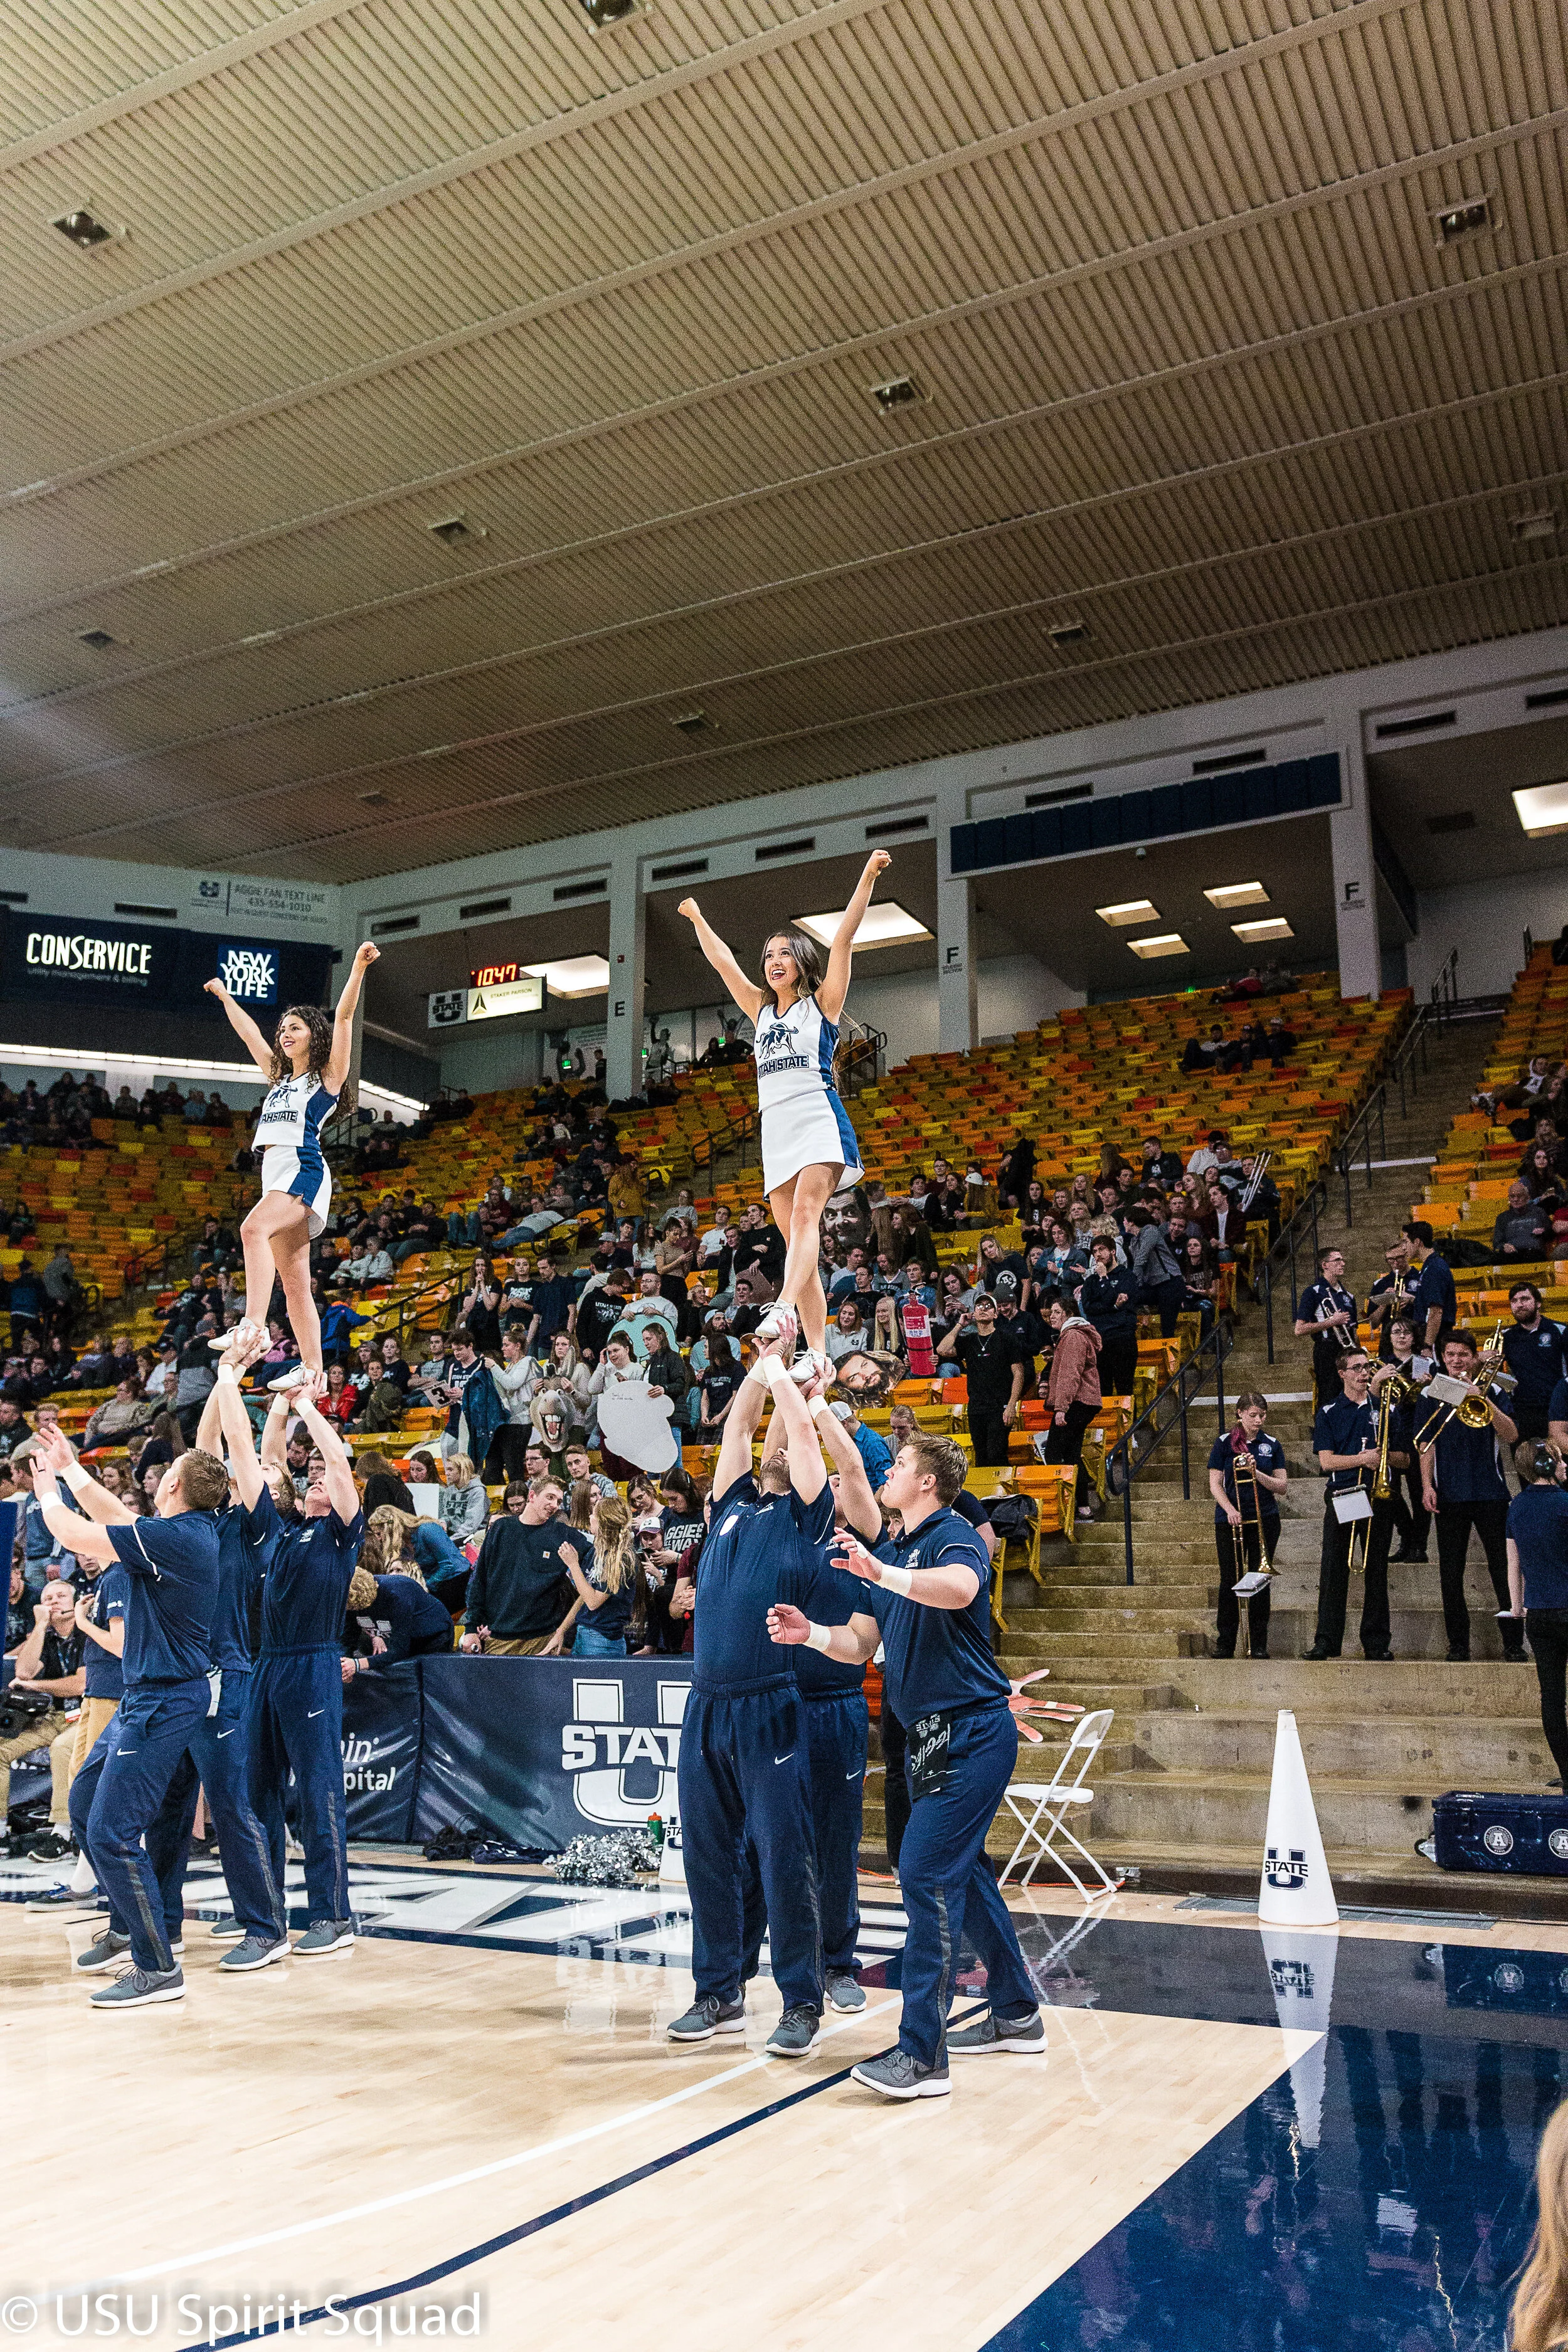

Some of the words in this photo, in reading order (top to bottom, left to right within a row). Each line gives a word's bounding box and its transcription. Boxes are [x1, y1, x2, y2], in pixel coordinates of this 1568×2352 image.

[235, 884, 262, 896] AGGIE
[263, 886, 282, 898] FAN
[284, 889, 304, 901] TEXT
[306, 891, 326, 903] LINE
[1345, 882, 1360, 900] F
[26, 933, 152, 974] CONSERVICE
[228, 950, 272, 968] NEW
[946, 946, 960, 964] F
[220, 962, 275, 985] YORK
[226, 978, 268, 998] LIFE
[615, 1001, 625, 1016] E
[776, 1055, 809, 1072] STATE
[273, 1110, 298, 1123] STATE
[431, 1387, 450, 1405] 3
[665, 1523, 705, 1540] GGIES
[1492, 1832, 1507, 1846] A
[1265, 1860, 1308, 1877] STATE
